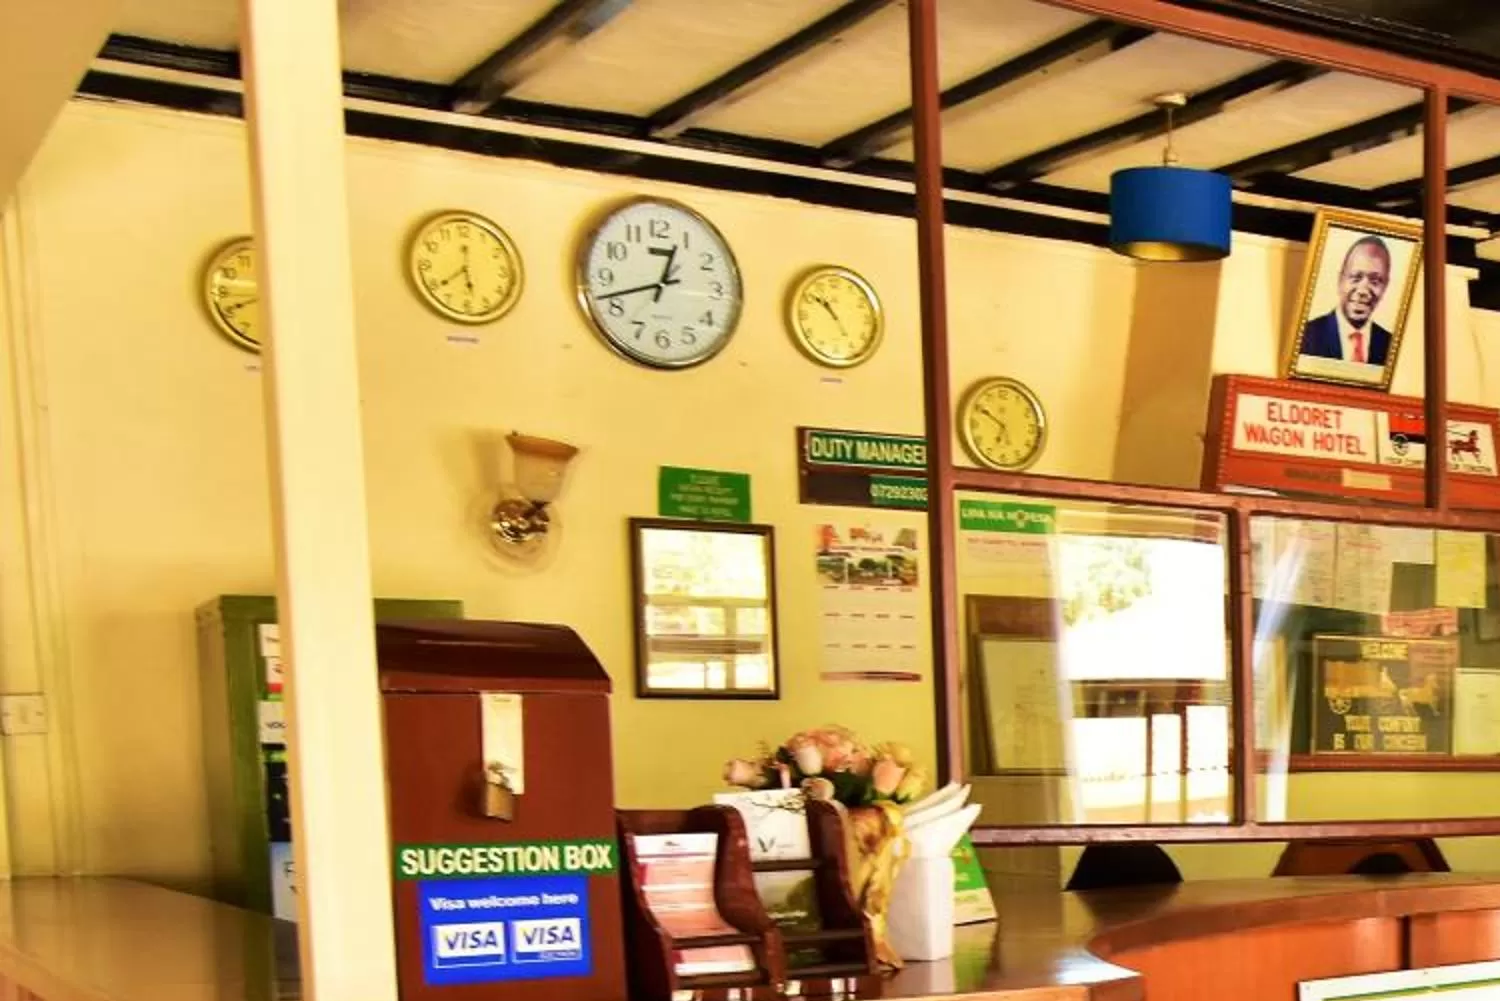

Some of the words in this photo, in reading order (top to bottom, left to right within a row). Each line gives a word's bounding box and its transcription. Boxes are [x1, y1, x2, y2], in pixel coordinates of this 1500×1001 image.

[625, 224, 641, 243] 11
[649, 219, 669, 239] 12
[683, 231, 689, 248] 1
[606, 241, 627, 261] 10
[700, 252, 714, 271] 2
[598, 267, 614, 286] 9
[708, 281, 723, 300] 3
[608, 299, 625, 317] 8
[699, 310, 714, 326] 4
[631, 321, 645, 339] 7
[655, 329, 671, 349] 6
[681, 325, 697, 345] 5
[1267, 401, 1343, 430] ELDORET
[1244, 422, 1305, 448] WAGON
[1313, 431, 1367, 456] HOTEL
[811, 436, 853, 459] DUTY
[856, 440, 927, 464] MANAGE
[401, 846, 561, 875] SUGGESTION
[564, 844, 613, 870] BOX
[429, 897, 466, 911] Visa
[467, 895, 540, 909] welcome
[541, 892, 579, 905] here
[443, 929, 499, 950] VISA
[521, 925, 575, 946] VISA
